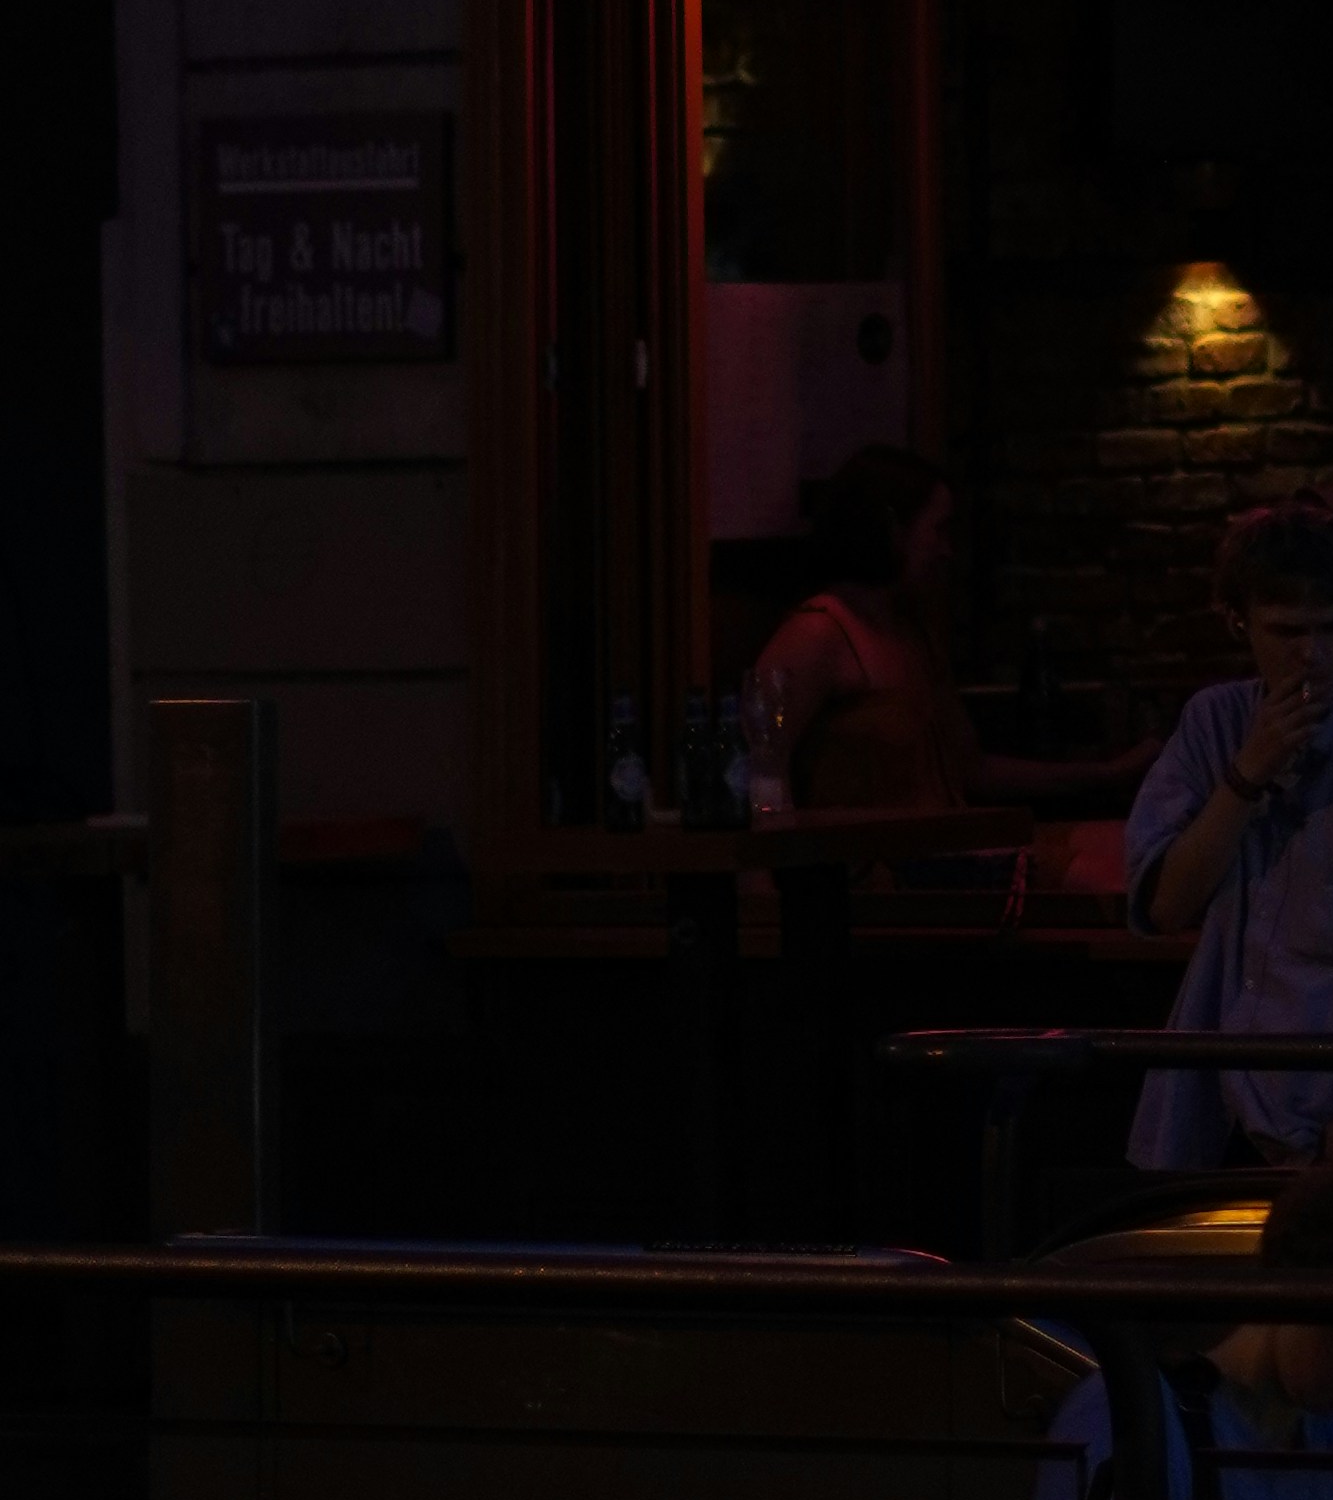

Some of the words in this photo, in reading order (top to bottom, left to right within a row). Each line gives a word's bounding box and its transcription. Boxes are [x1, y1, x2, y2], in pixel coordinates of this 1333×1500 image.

[219, 222, 274, 283] Tag
[290, 220, 314, 271] &
[330, 218, 423, 271] Nacht
[239, 280, 405, 335] freihalten!
